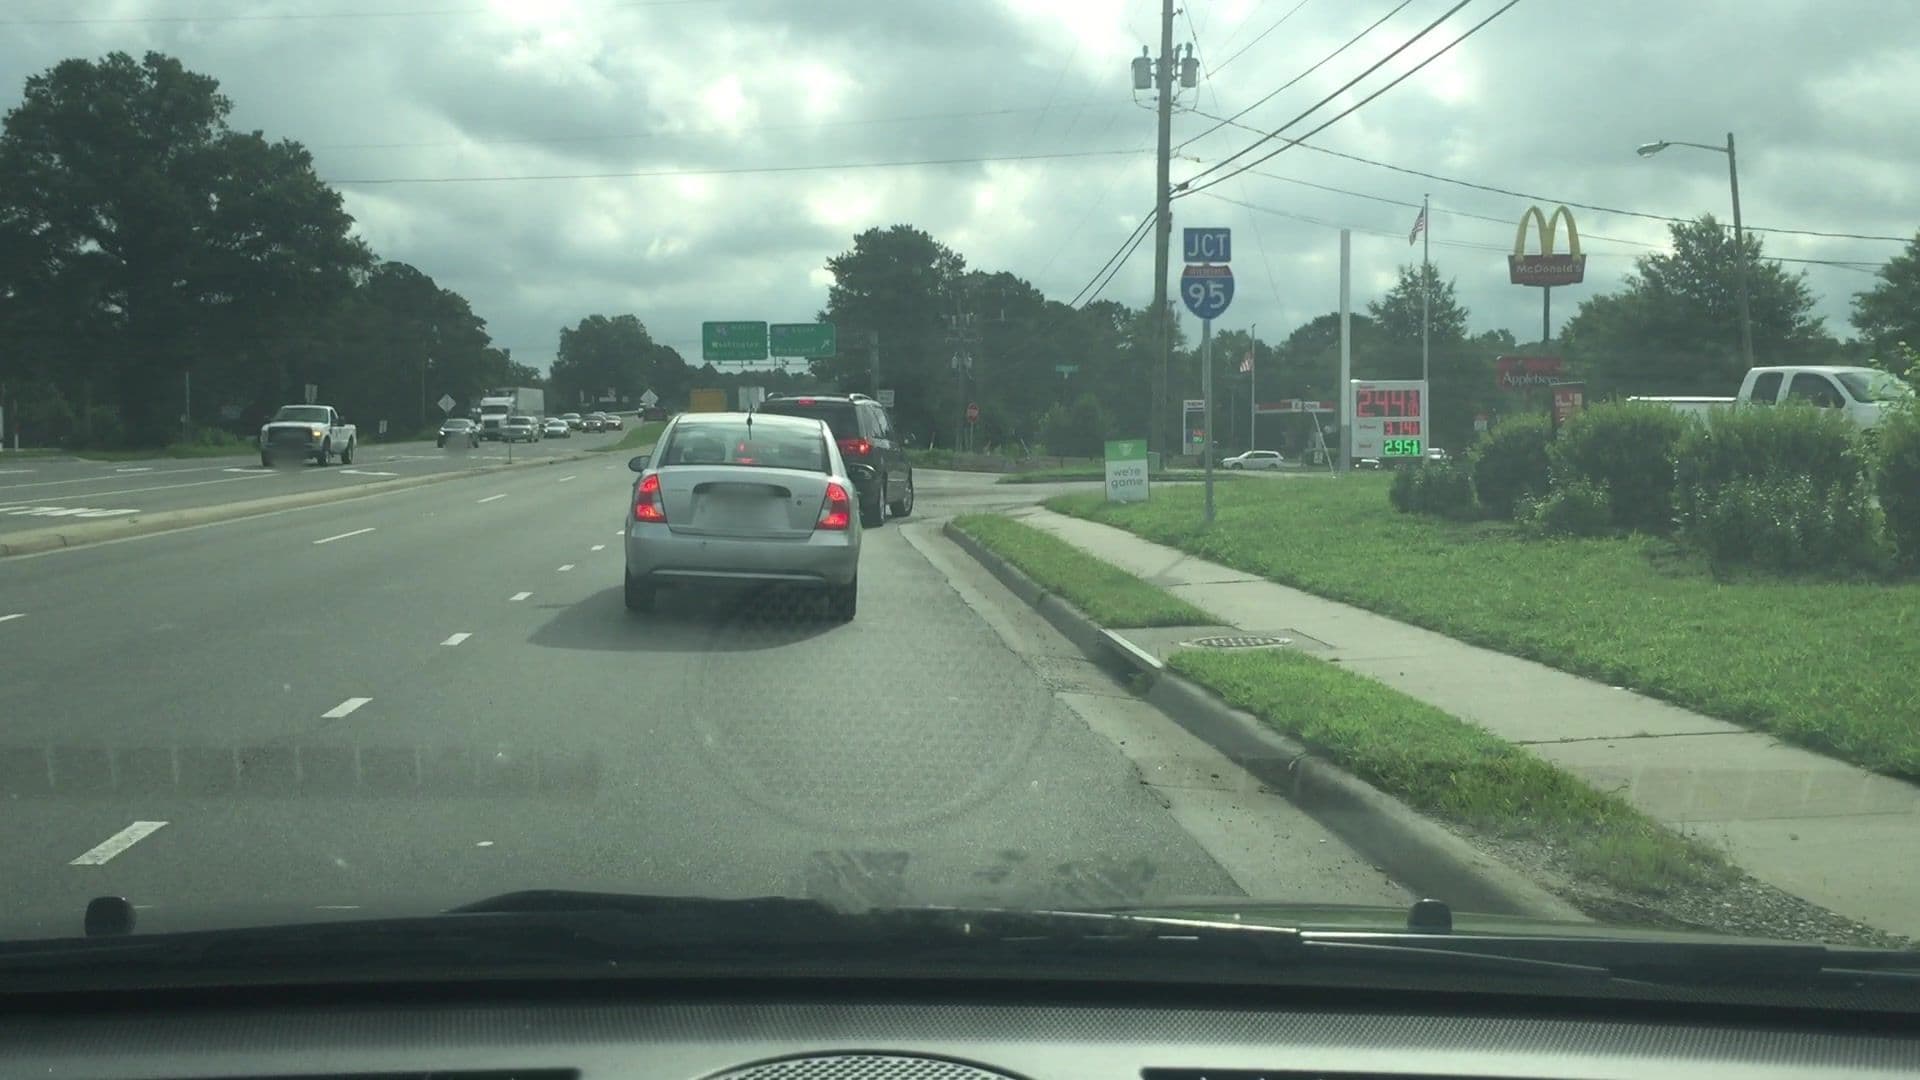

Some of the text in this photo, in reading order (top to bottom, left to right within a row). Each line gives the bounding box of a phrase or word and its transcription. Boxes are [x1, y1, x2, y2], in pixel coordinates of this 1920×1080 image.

[1187, 233, 1228, 257] JCT
[1516, 263, 1582, 273] McDonald's
[1188, 283, 1225, 309] 95
[1111, 479, 1144, 489] game
